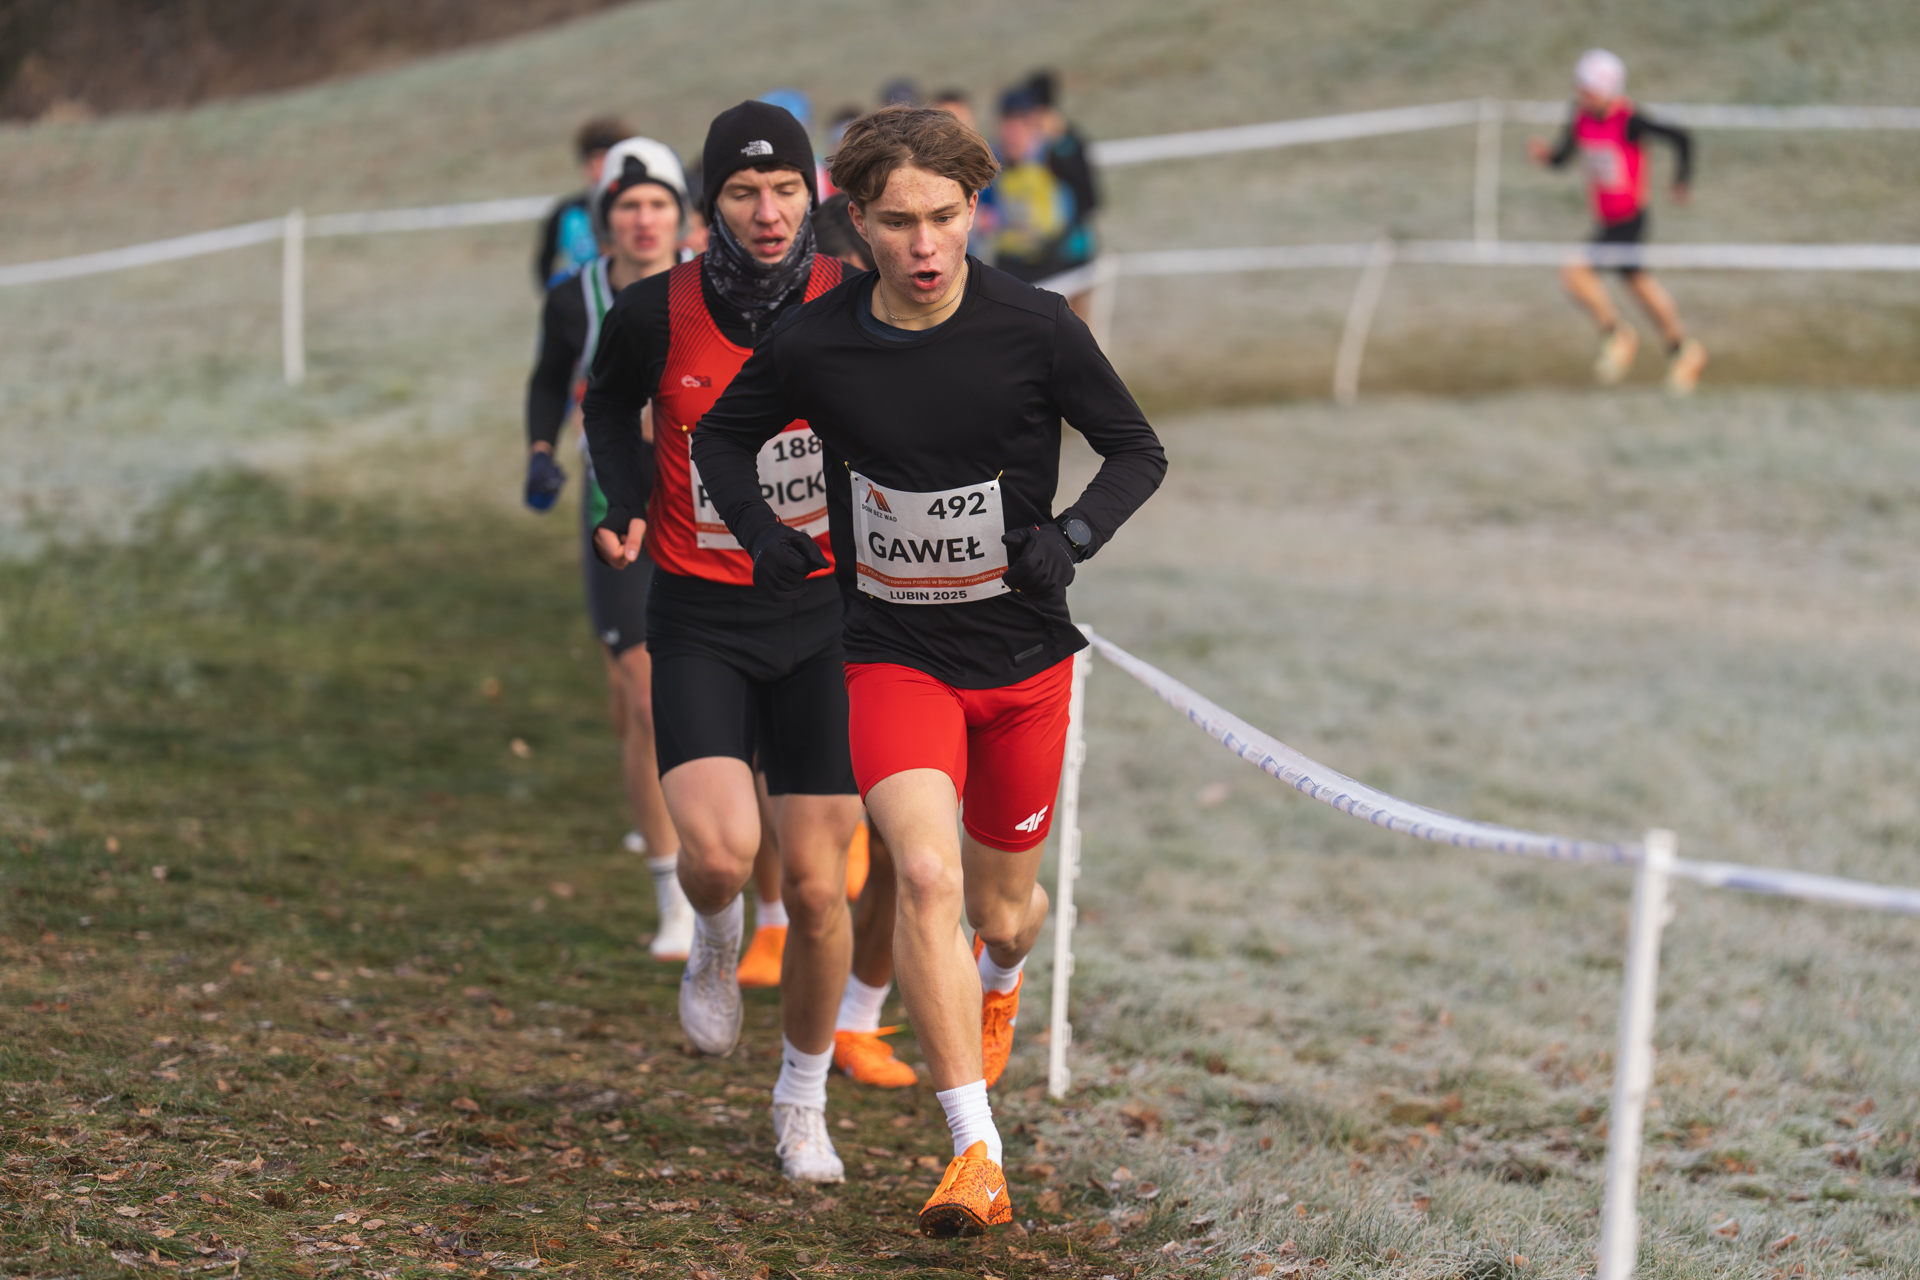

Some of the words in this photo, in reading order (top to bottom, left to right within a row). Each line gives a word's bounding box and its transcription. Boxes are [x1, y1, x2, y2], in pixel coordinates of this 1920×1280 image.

[861, 503, 873, 514] DOM
[873, 509, 883, 519] BEZ
[884, 514, 898, 523] WAD
[927, 492, 987, 520] 492
[868, 531, 985, 564] GAWEŁ
[938, 578, 964, 586] Biegach
[890, 590, 930, 601] LUBIN
[932, 590, 968, 601] 2025
[1014, 805, 1049, 833] 4F
